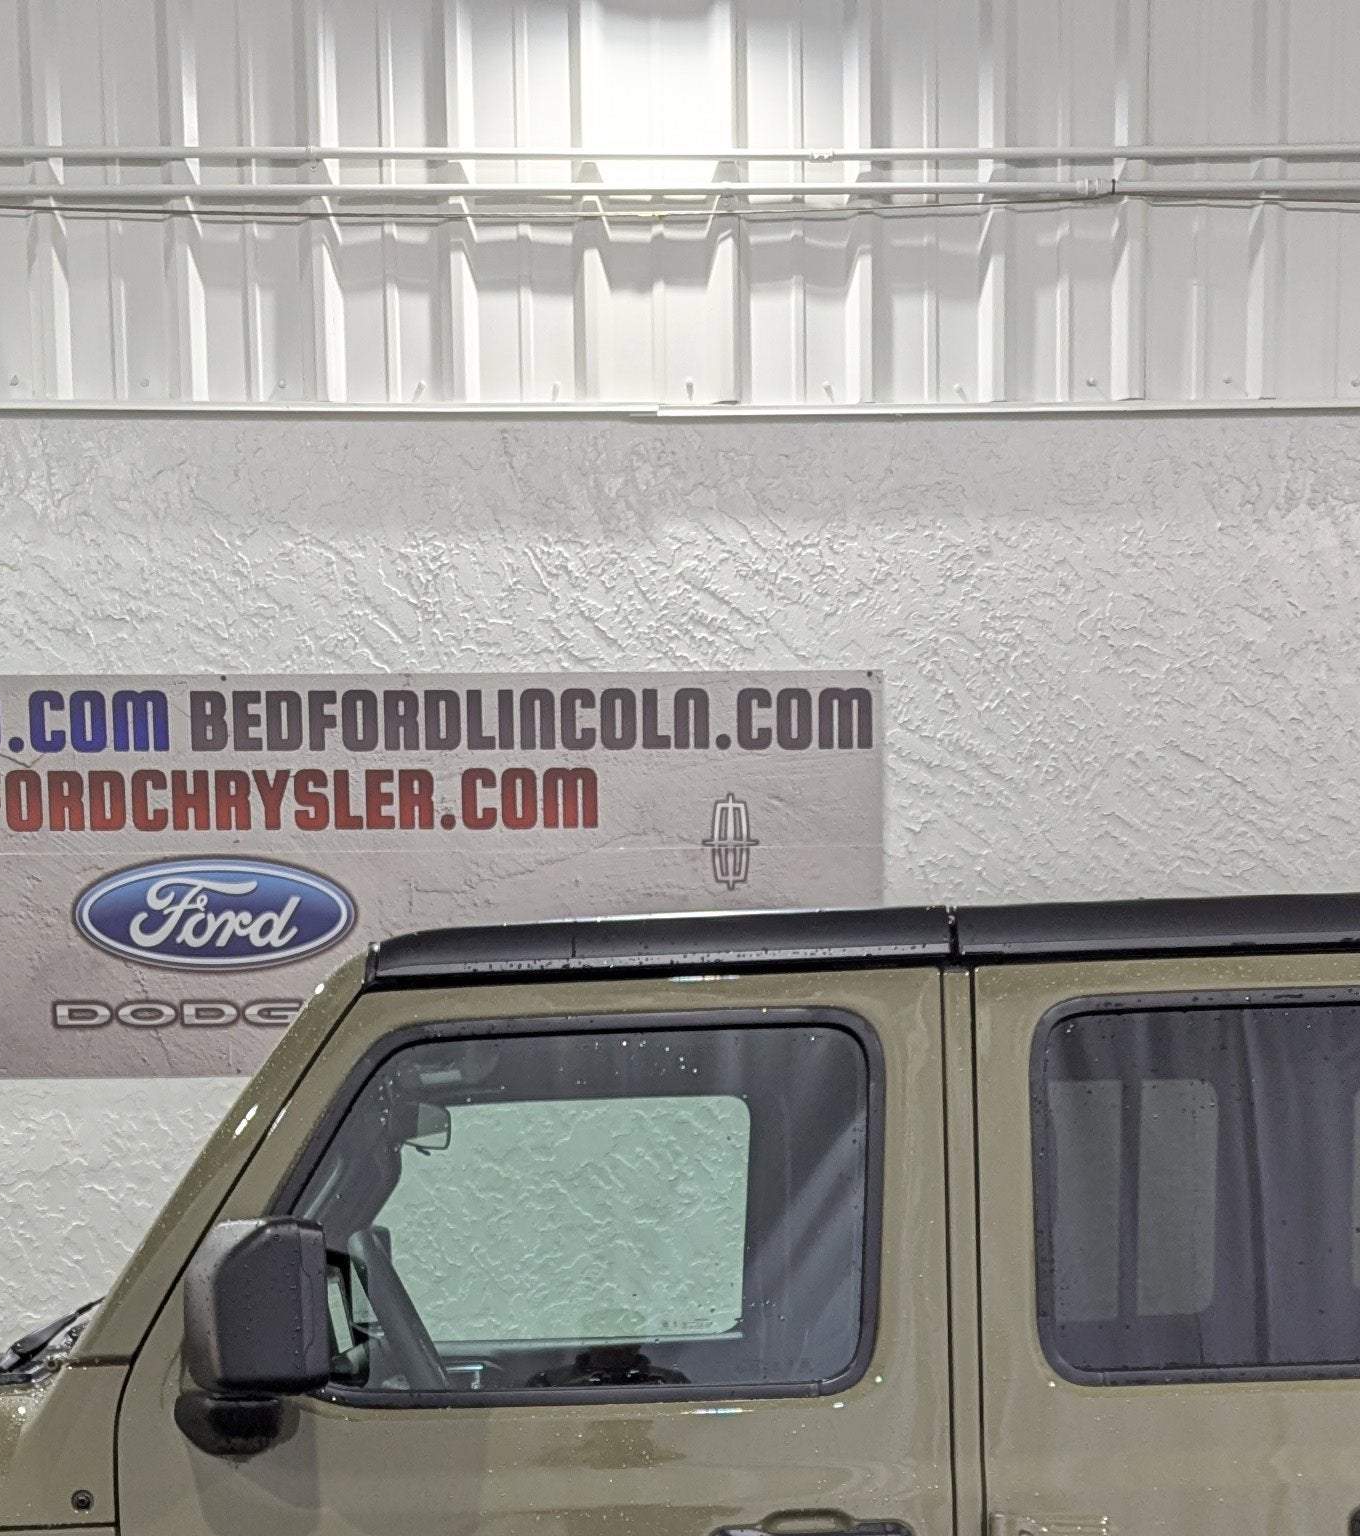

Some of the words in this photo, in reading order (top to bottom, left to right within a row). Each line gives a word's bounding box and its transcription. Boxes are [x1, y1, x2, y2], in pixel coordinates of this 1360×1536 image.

[189, 687, 875, 752] BEDFORDLINCOLN.COM
[129, 878, 301, 949] Ford
[53, 1001, 306, 1028] DODG
